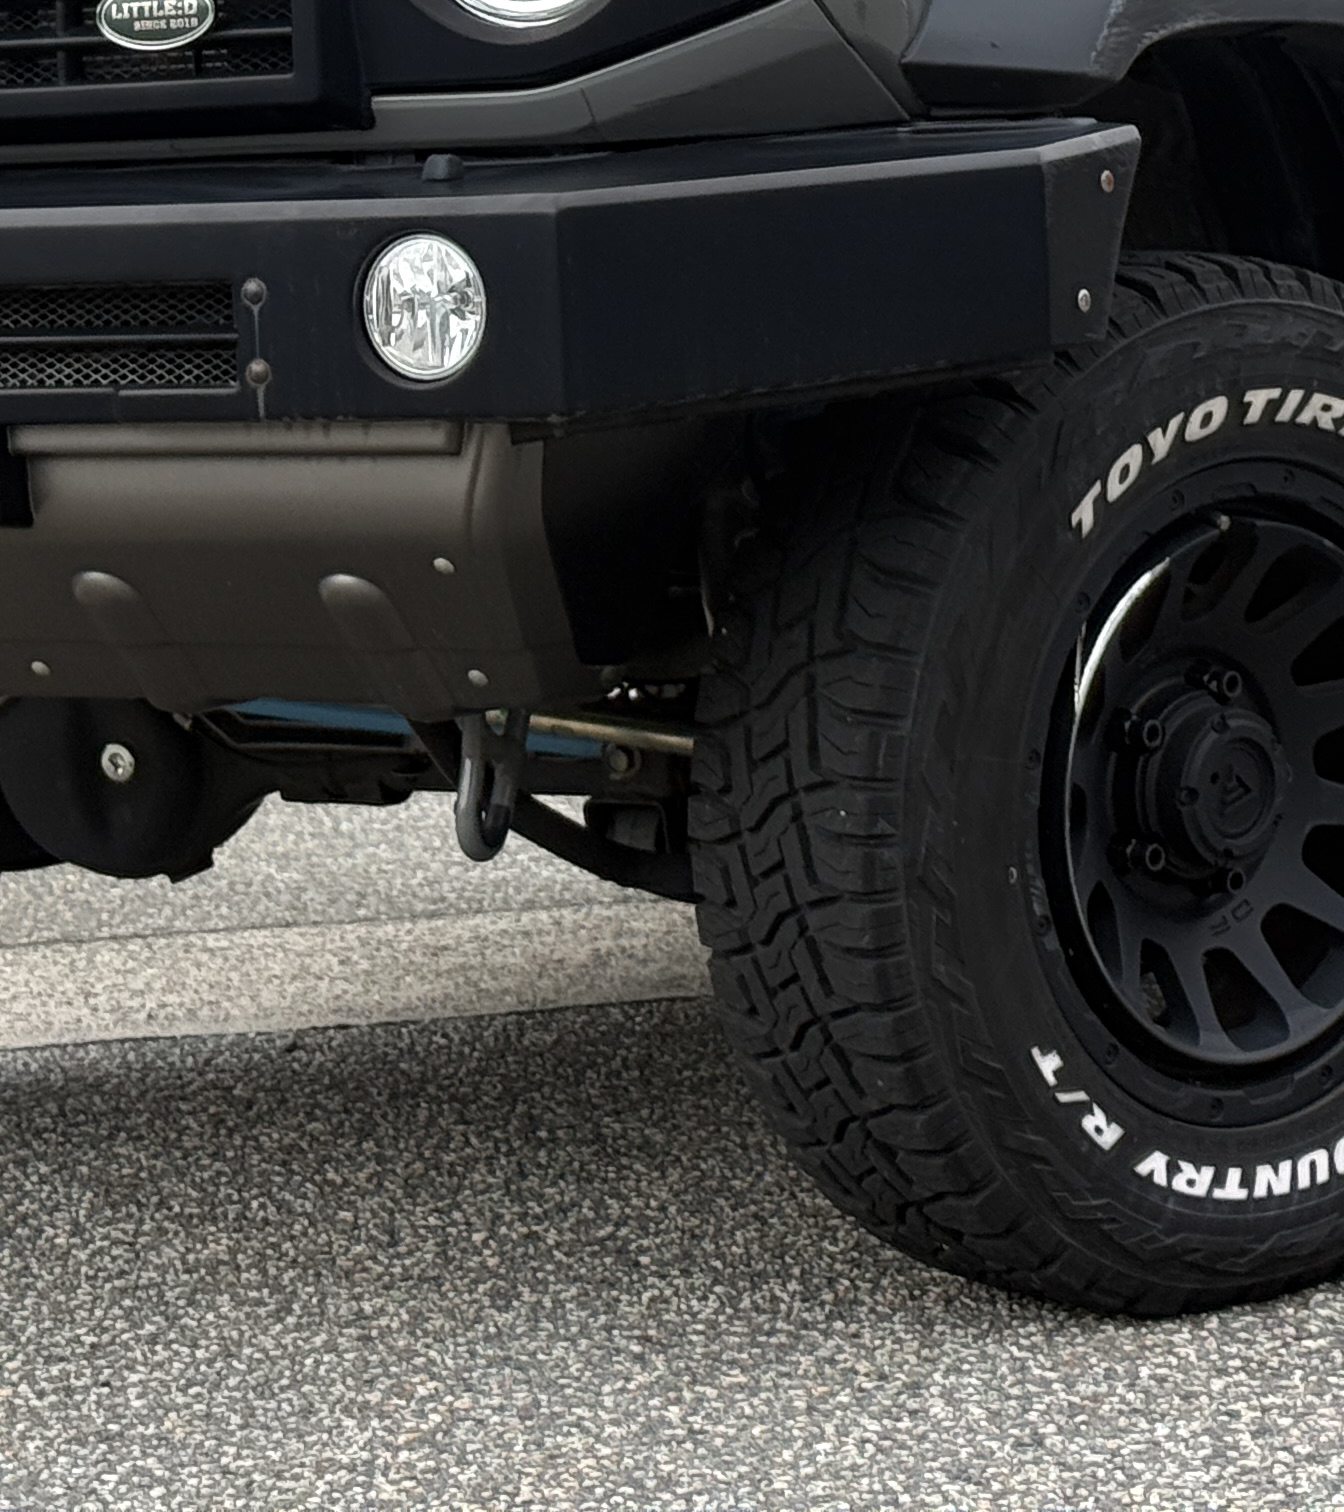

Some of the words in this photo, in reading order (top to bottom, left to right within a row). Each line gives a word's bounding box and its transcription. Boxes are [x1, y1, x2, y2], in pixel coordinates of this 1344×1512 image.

[133, 18, 167, 31] SINCE
[1069, 393, 1229, 538] TOYO
[1029, 1043, 1126, 1153] R/T
